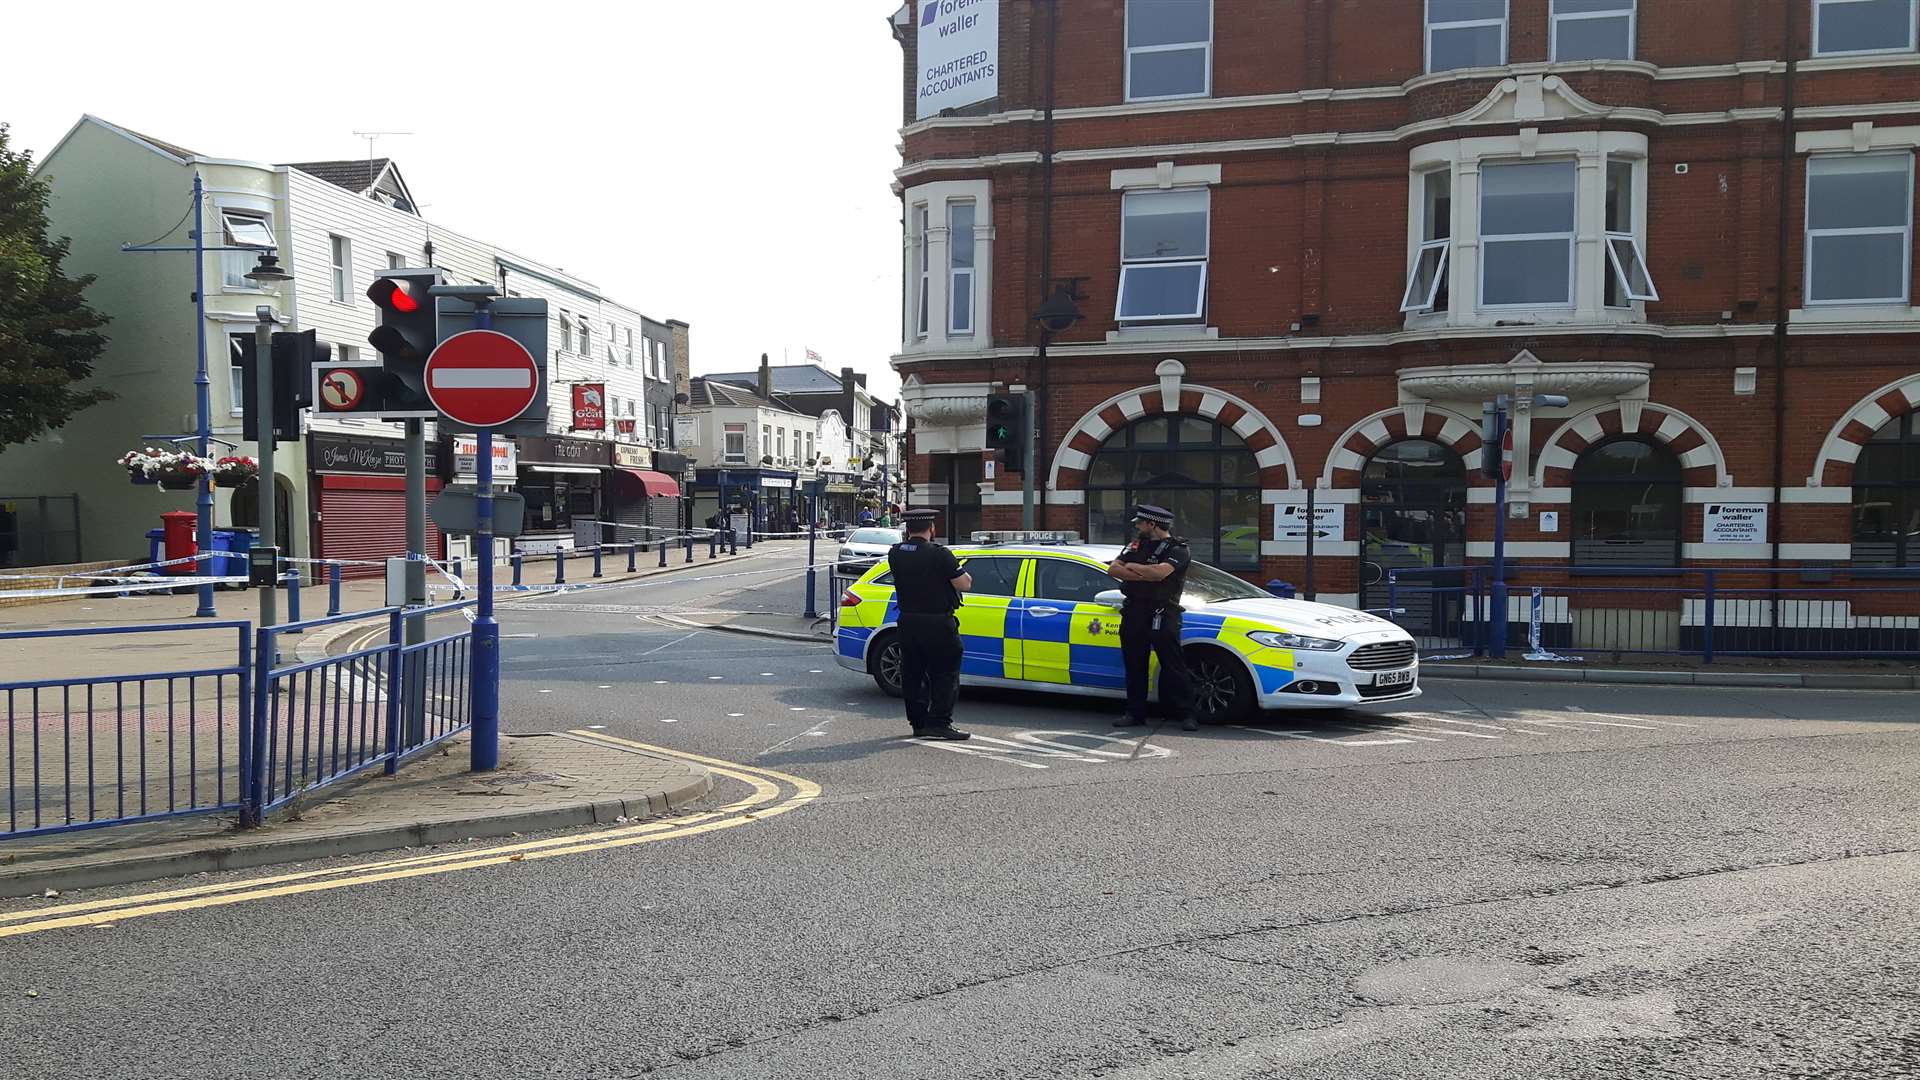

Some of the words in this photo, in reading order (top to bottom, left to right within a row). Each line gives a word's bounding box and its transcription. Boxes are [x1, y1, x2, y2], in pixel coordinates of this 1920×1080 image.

[939, 14, 979, 37] waller
[926, 51, 988, 81] CHARTERED
[920, 64, 994, 98] ACCOUNTANTS
[576, 409, 603, 418] Goat
[567, 446, 581, 457] GOAT
[1029, 531, 1052, 540] POLICE
[1379, 671, 1396, 685] GN65
[1397, 670, 1410, 683] BWB
